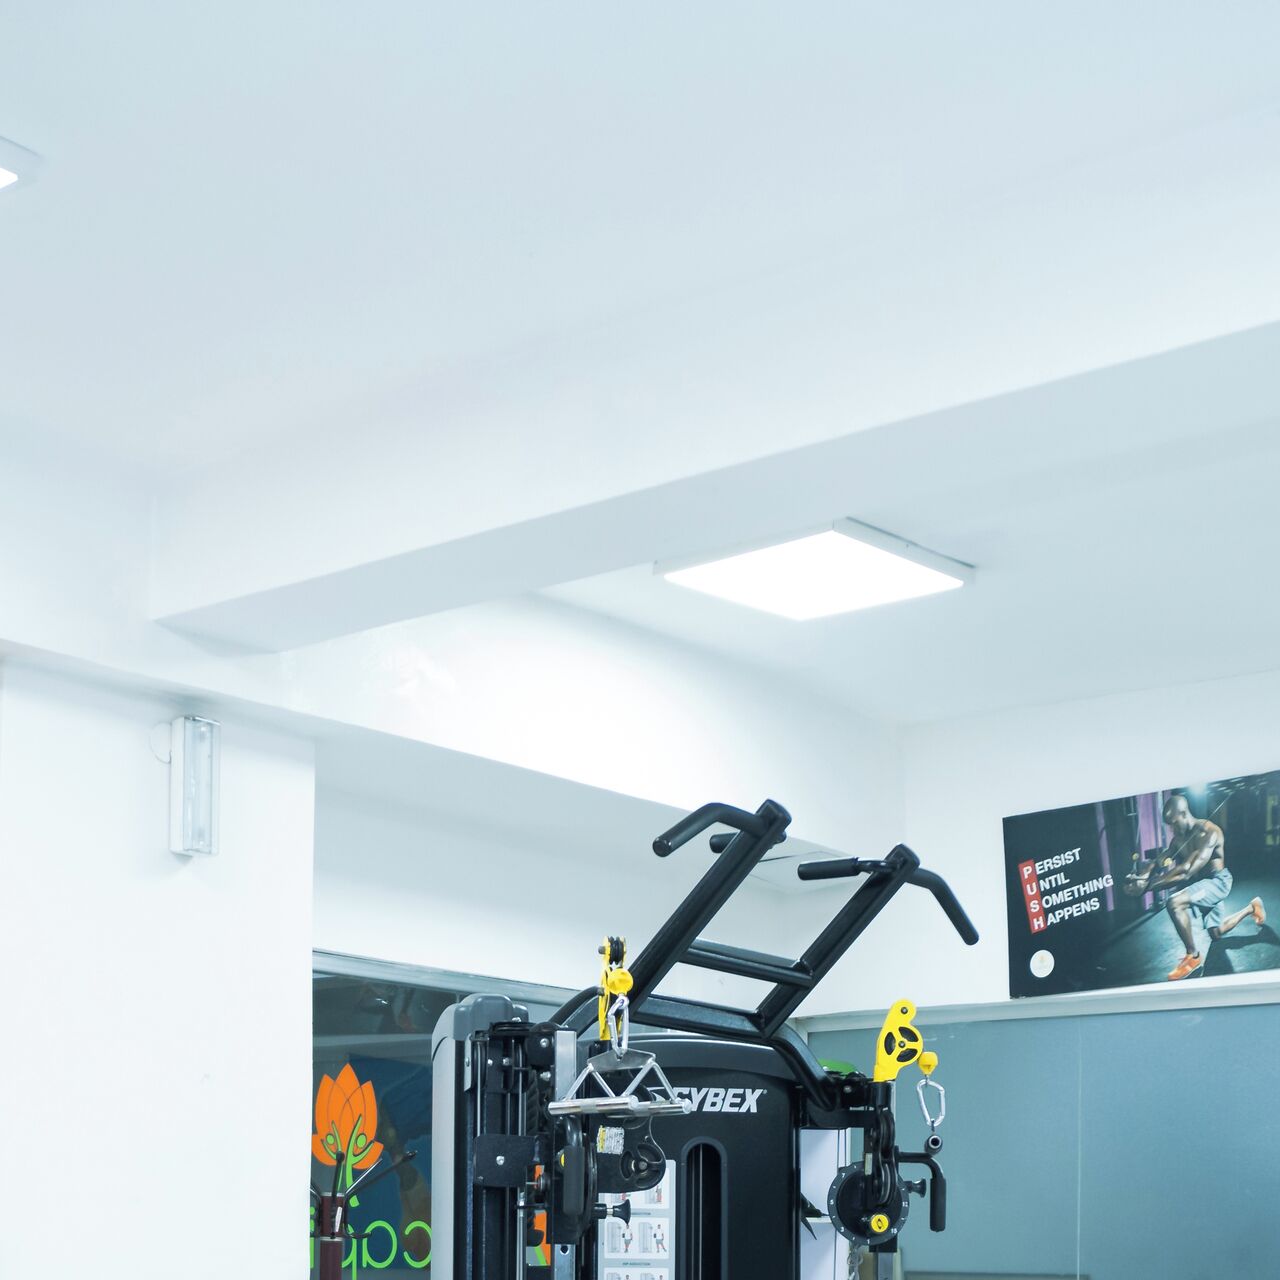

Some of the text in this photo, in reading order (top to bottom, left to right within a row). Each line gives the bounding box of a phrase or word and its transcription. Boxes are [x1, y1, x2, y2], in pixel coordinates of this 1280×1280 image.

[1023, 848, 1081, 879] PERSIST
[1026, 872, 1070, 895] UNTIL
[1030, 874, 1113, 912] SOMETHING
[1033, 897, 1100, 930] HAPPENS
